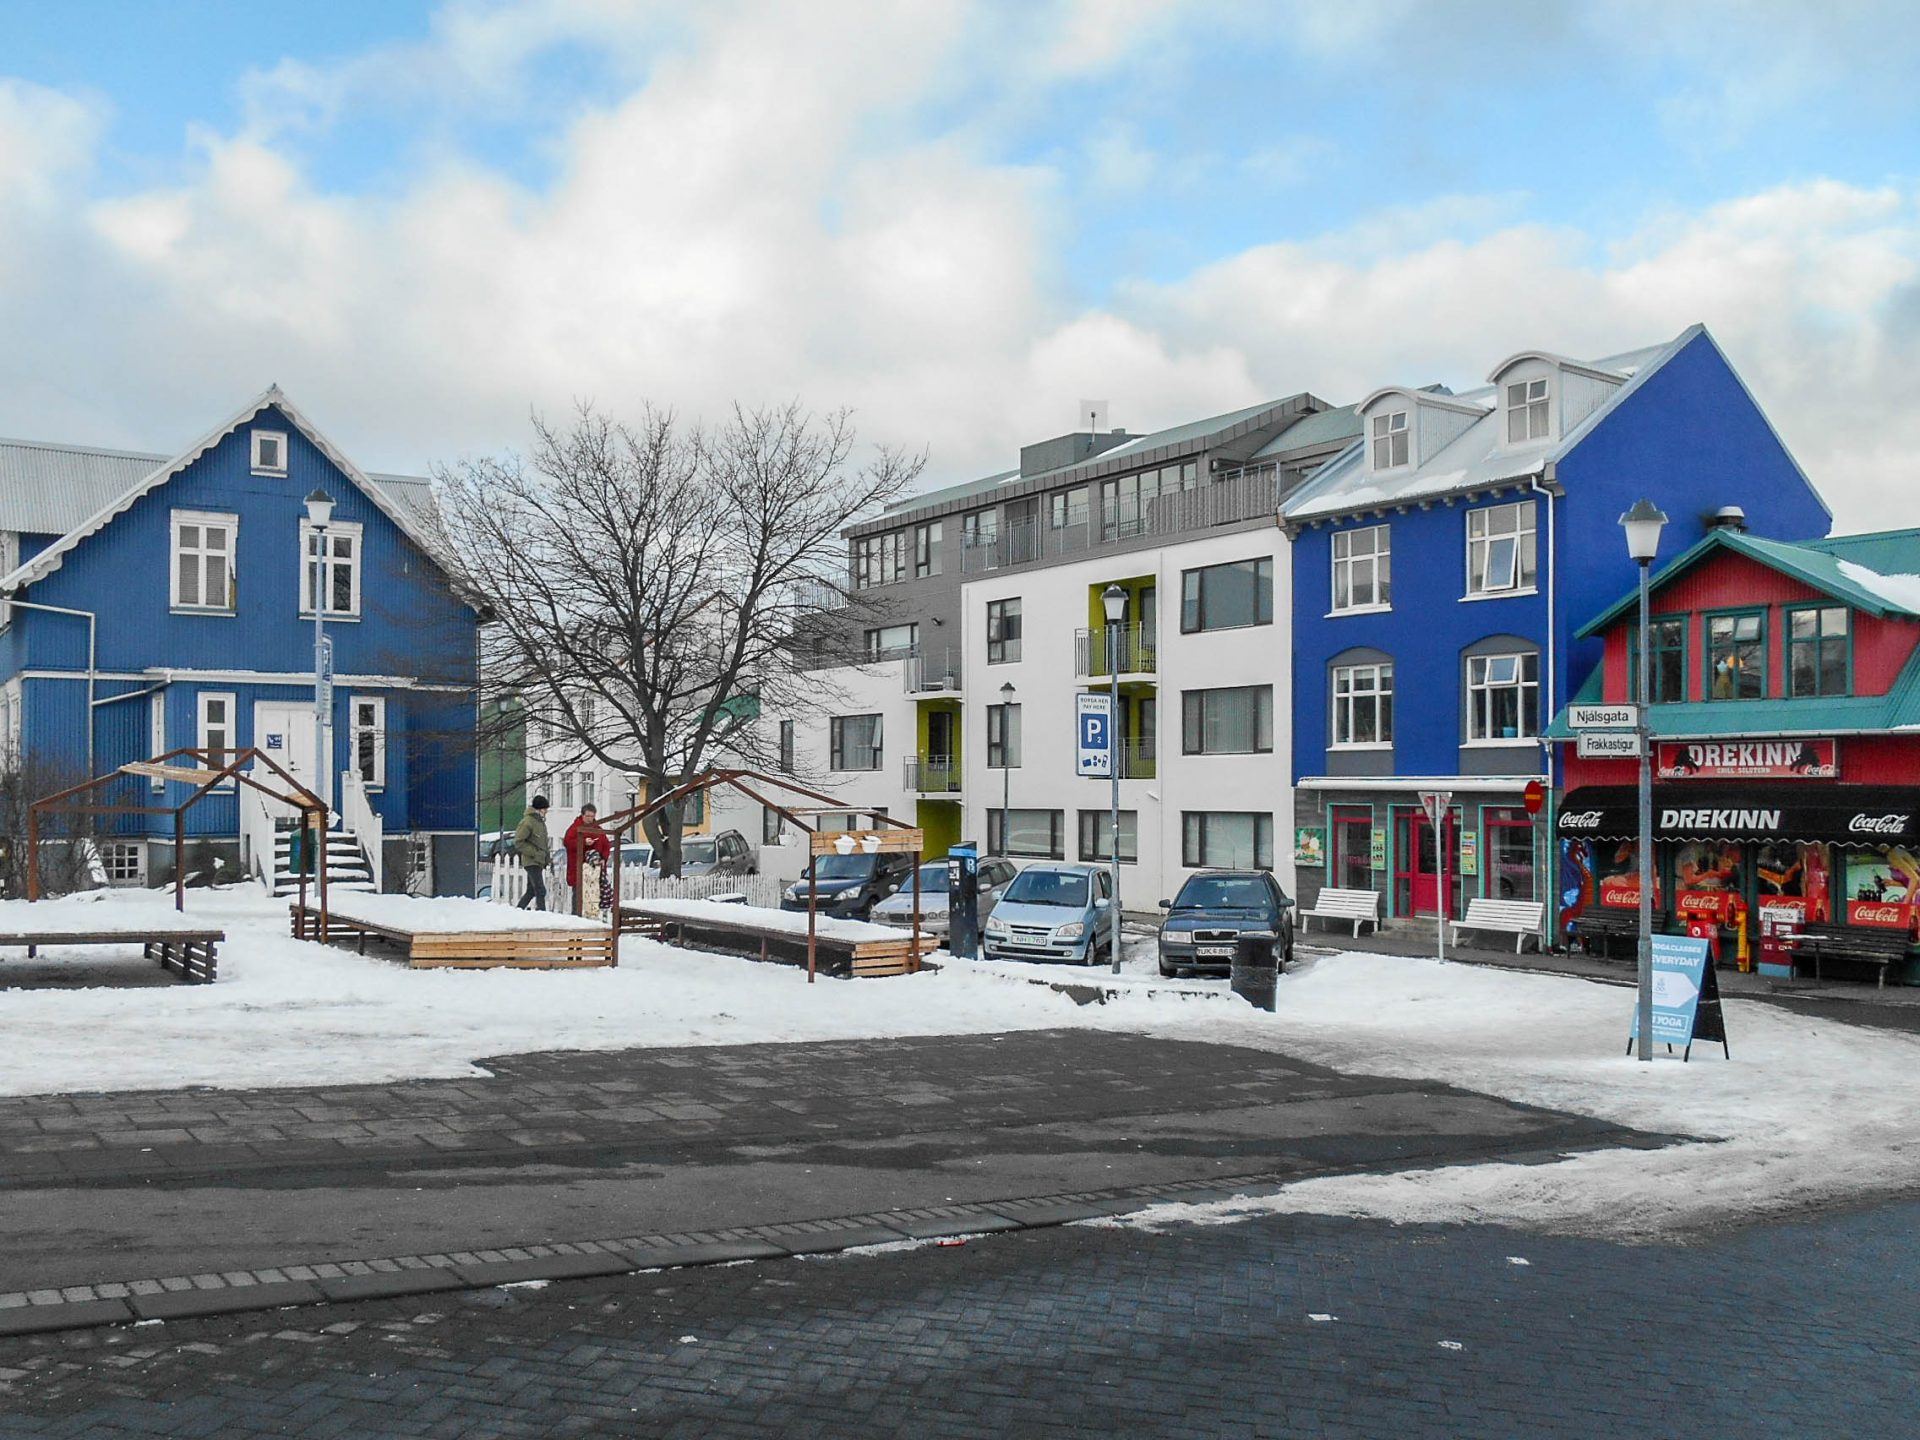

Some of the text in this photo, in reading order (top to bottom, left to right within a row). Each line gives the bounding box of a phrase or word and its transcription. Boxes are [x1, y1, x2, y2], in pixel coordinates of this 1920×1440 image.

[1087, 718, 1102, 743] P
[1688, 742, 1802, 767] DREKINN
[1660, 809, 1781, 829] DREKINN
